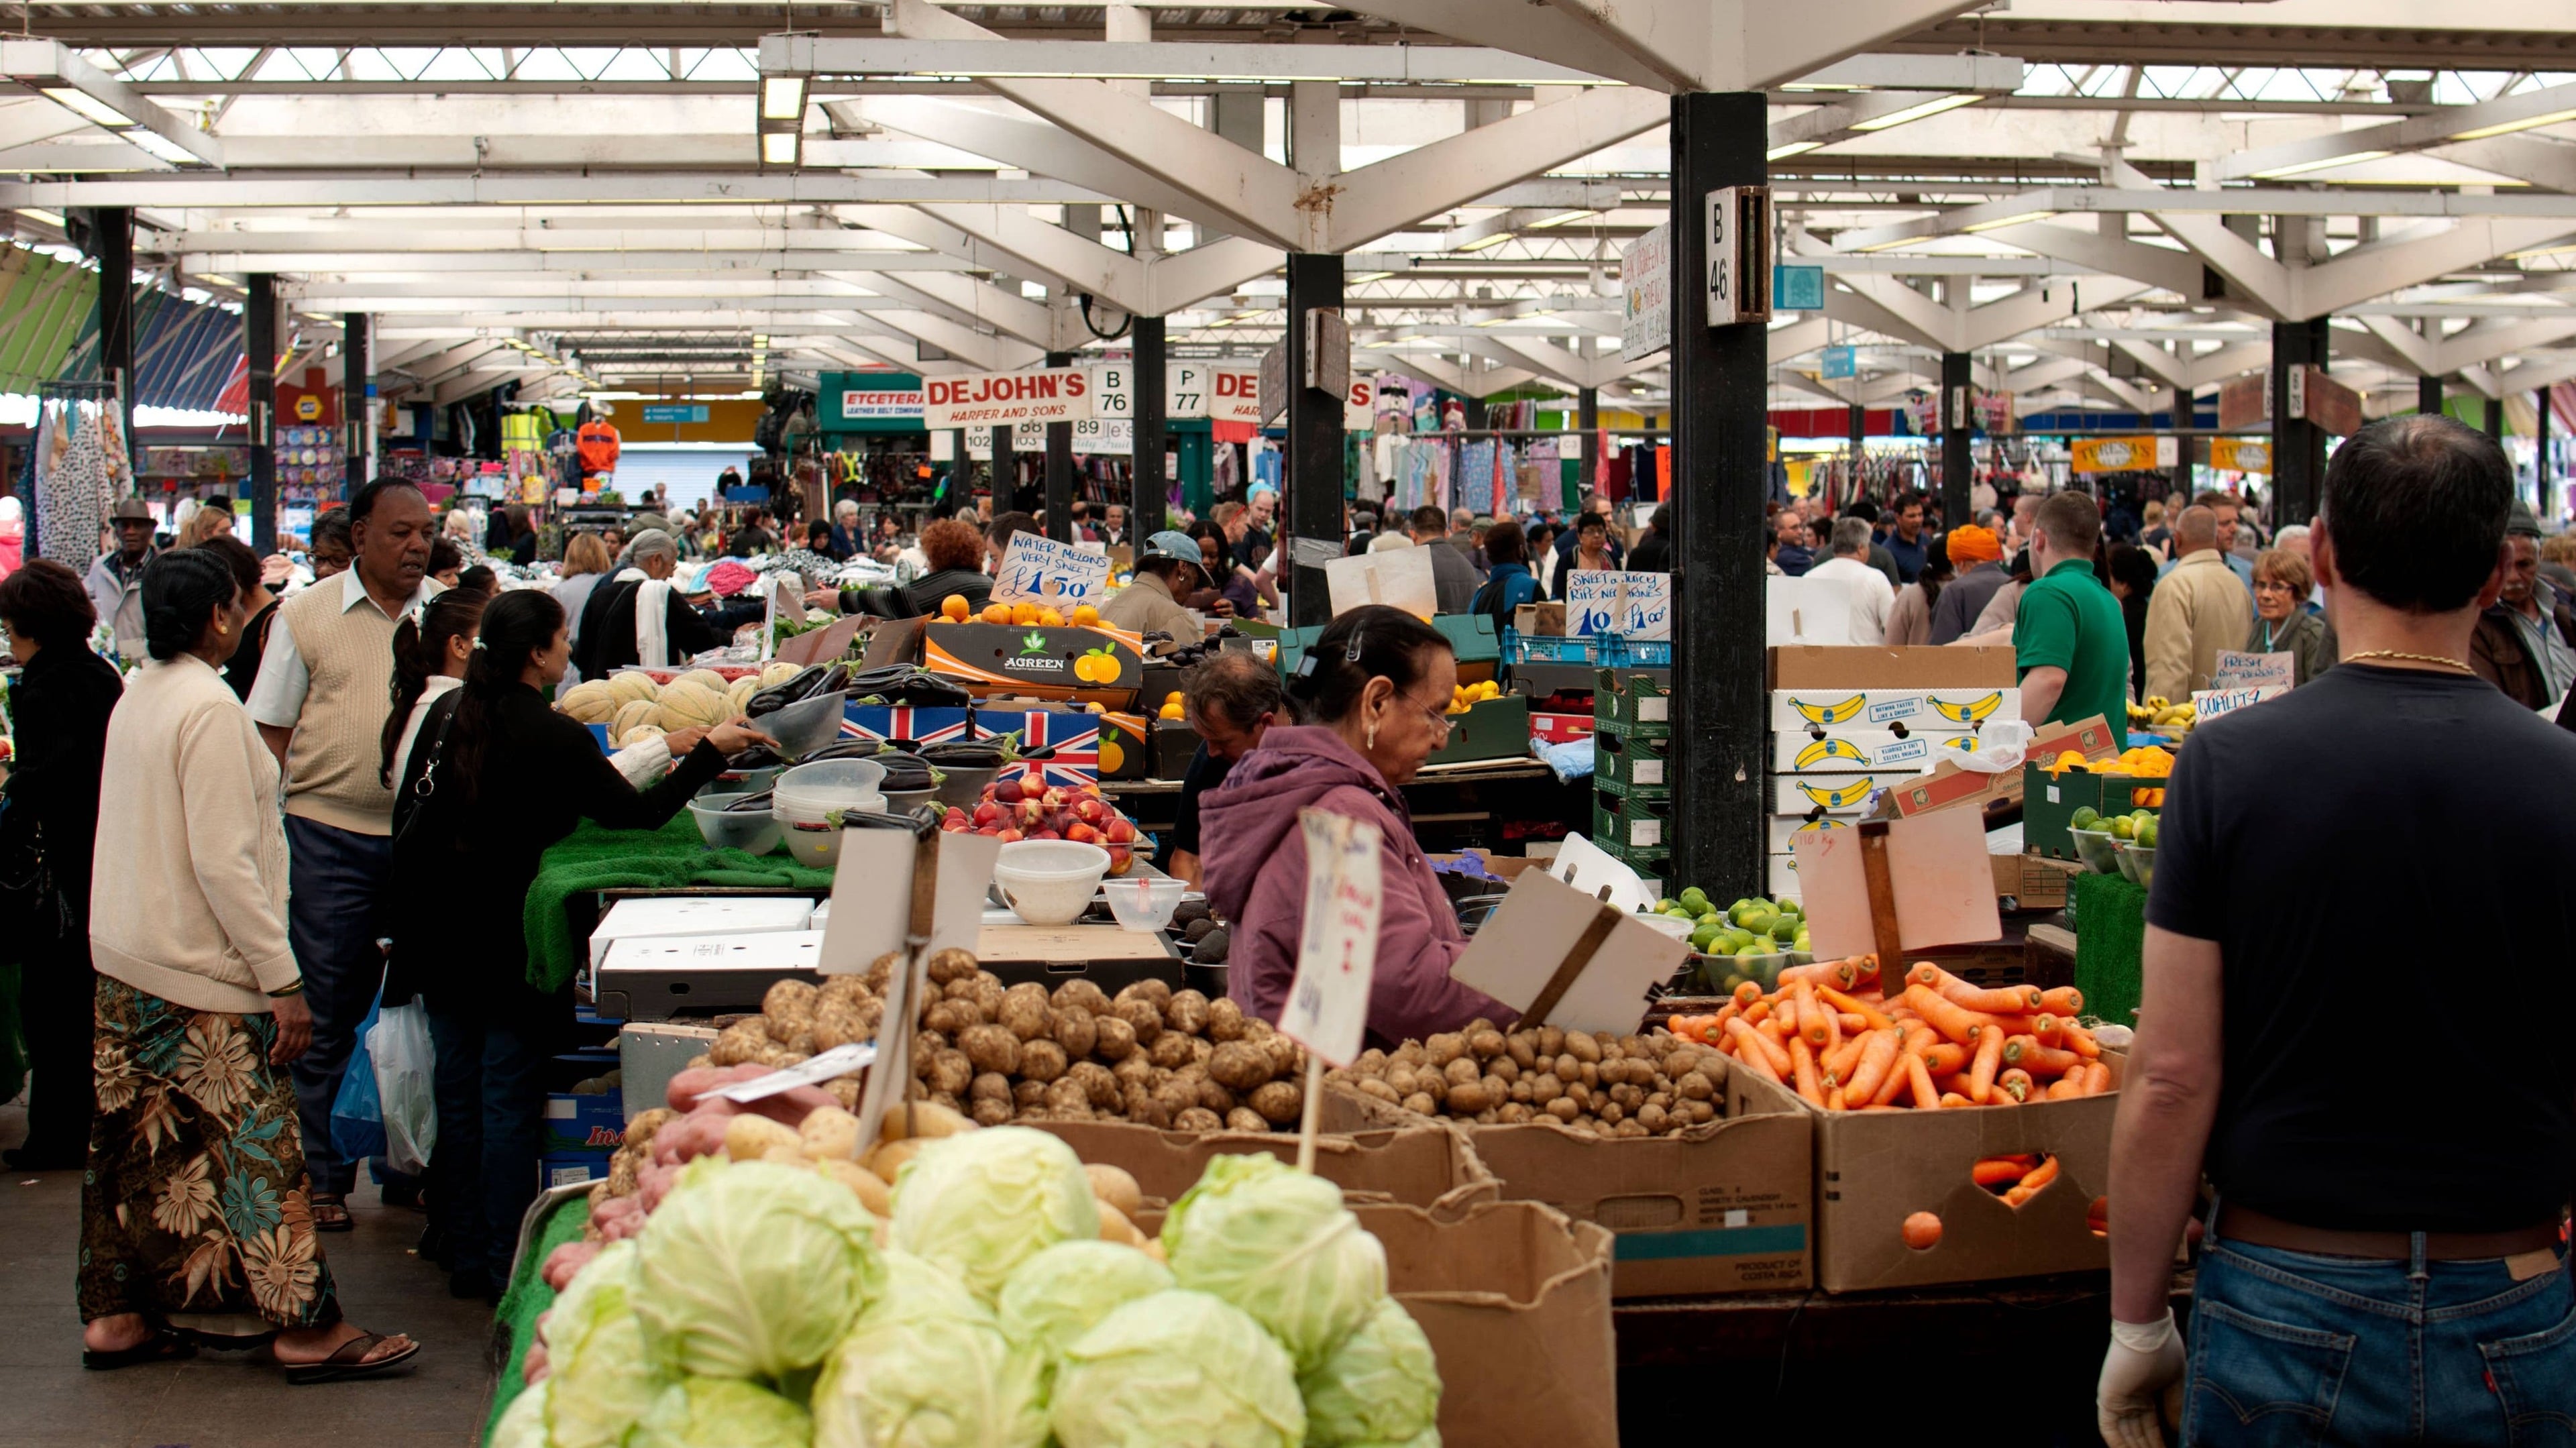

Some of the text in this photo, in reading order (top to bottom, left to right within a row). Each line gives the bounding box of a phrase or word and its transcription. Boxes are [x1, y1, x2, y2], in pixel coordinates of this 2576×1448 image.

[1714, 203, 1723, 243] B
[1711, 258, 1727, 300] 46
[1107, 372, 1120, 388] B
[1182, 370, 1194, 386] P
[1101, 394, 1126, 410] 76
[1175, 394, 1200, 410] 77
[950, 404, 1067, 422] HARPER AND SONS
[1077, 421, 1099, 434] 89
[969, 437, 990, 447] 102
[1014, 535, 1107, 568] WATER MELONS
[1022, 552, 1092, 576] VERY SWEET
[1572, 573, 1607, 586] SWEET
[1570, 587, 1595, 601] RIPE
[1578, 608, 1611, 635] 10
[1004, 657, 1065, 669] AGREEN
[1876, 704, 1895, 712] NOTHING
[2198, 690, 2260, 716] QUALITY
[586, 1125, 626, 1146] Inv
[1735, 1258, 1801, 1270] PRODUCT OF
[1741, 1271, 1776, 1280] COSTA
